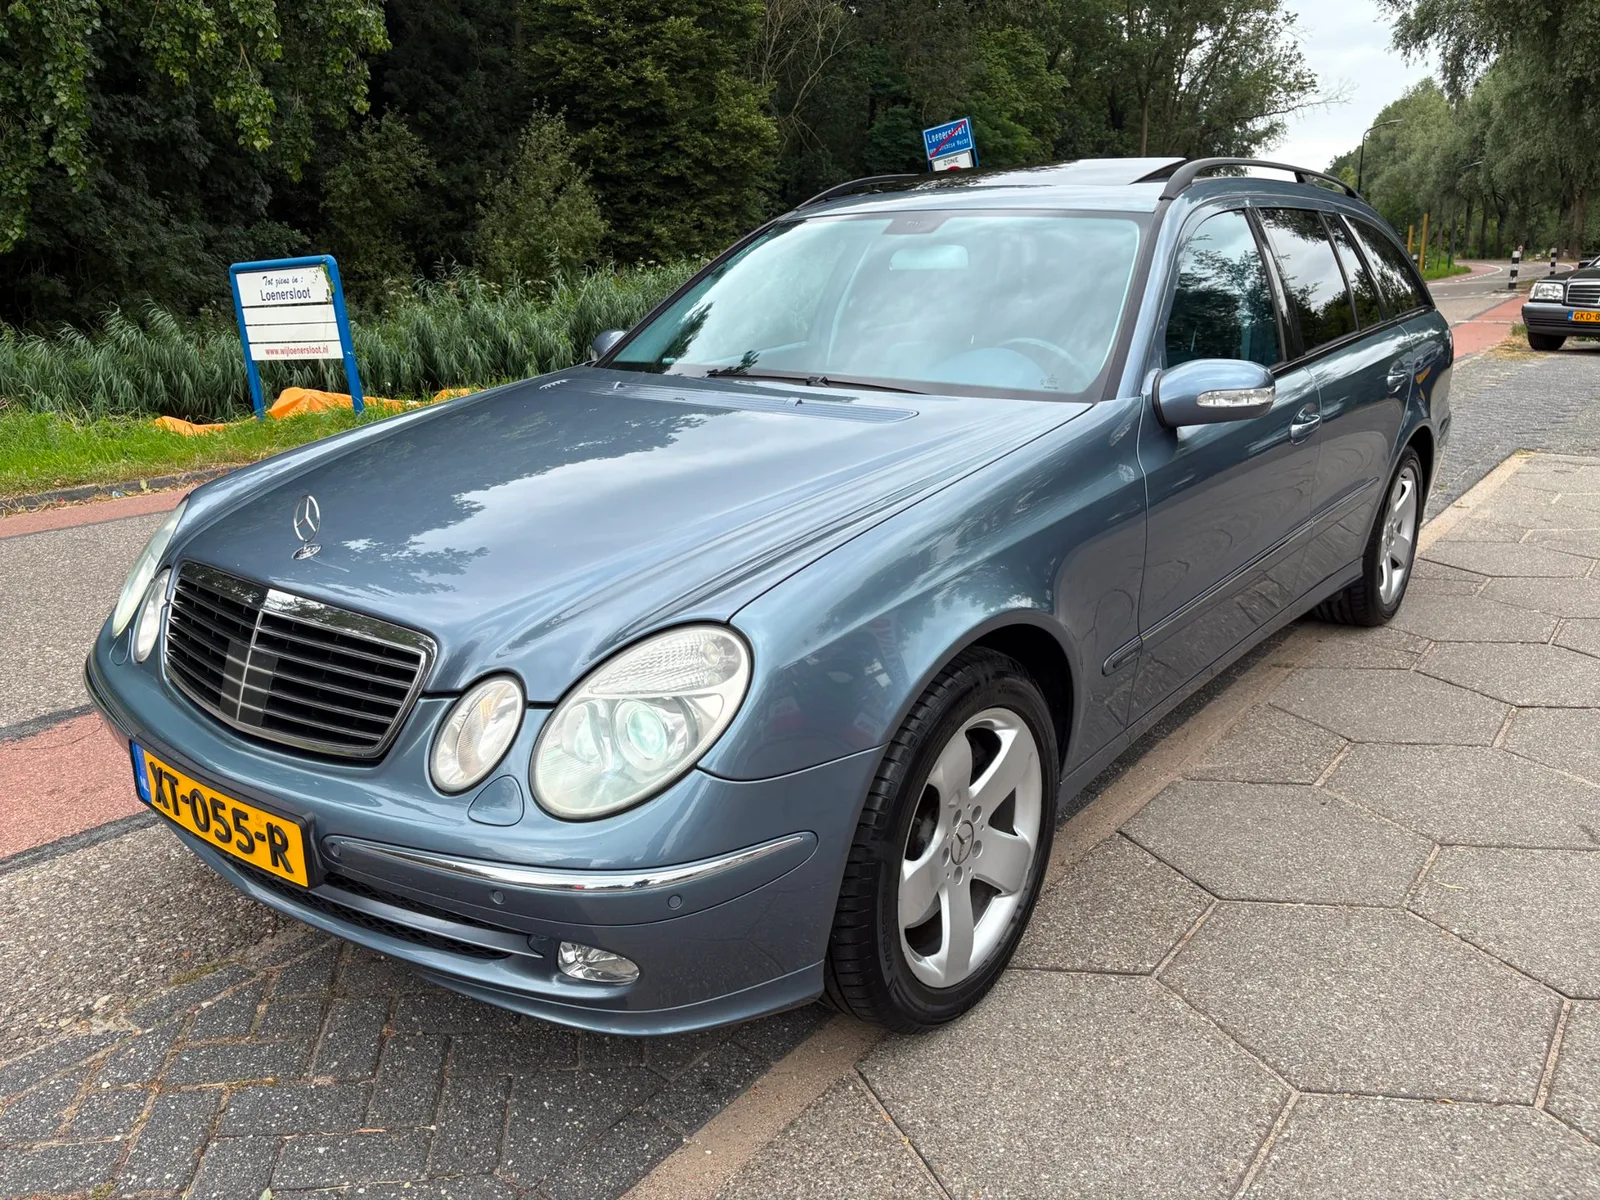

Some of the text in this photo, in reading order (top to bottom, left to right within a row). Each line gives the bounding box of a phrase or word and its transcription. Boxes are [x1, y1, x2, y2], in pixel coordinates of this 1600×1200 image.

[927, 125, 965, 143] Loenersloot
[943, 157, 959, 166] ZONE
[260, 287, 311, 301] Loenersloot
[265, 345, 329, 356] www.wijloenersloot.nl
[139, 775, 150, 793] NL
[149, 762, 294, 873] XT-055-R
